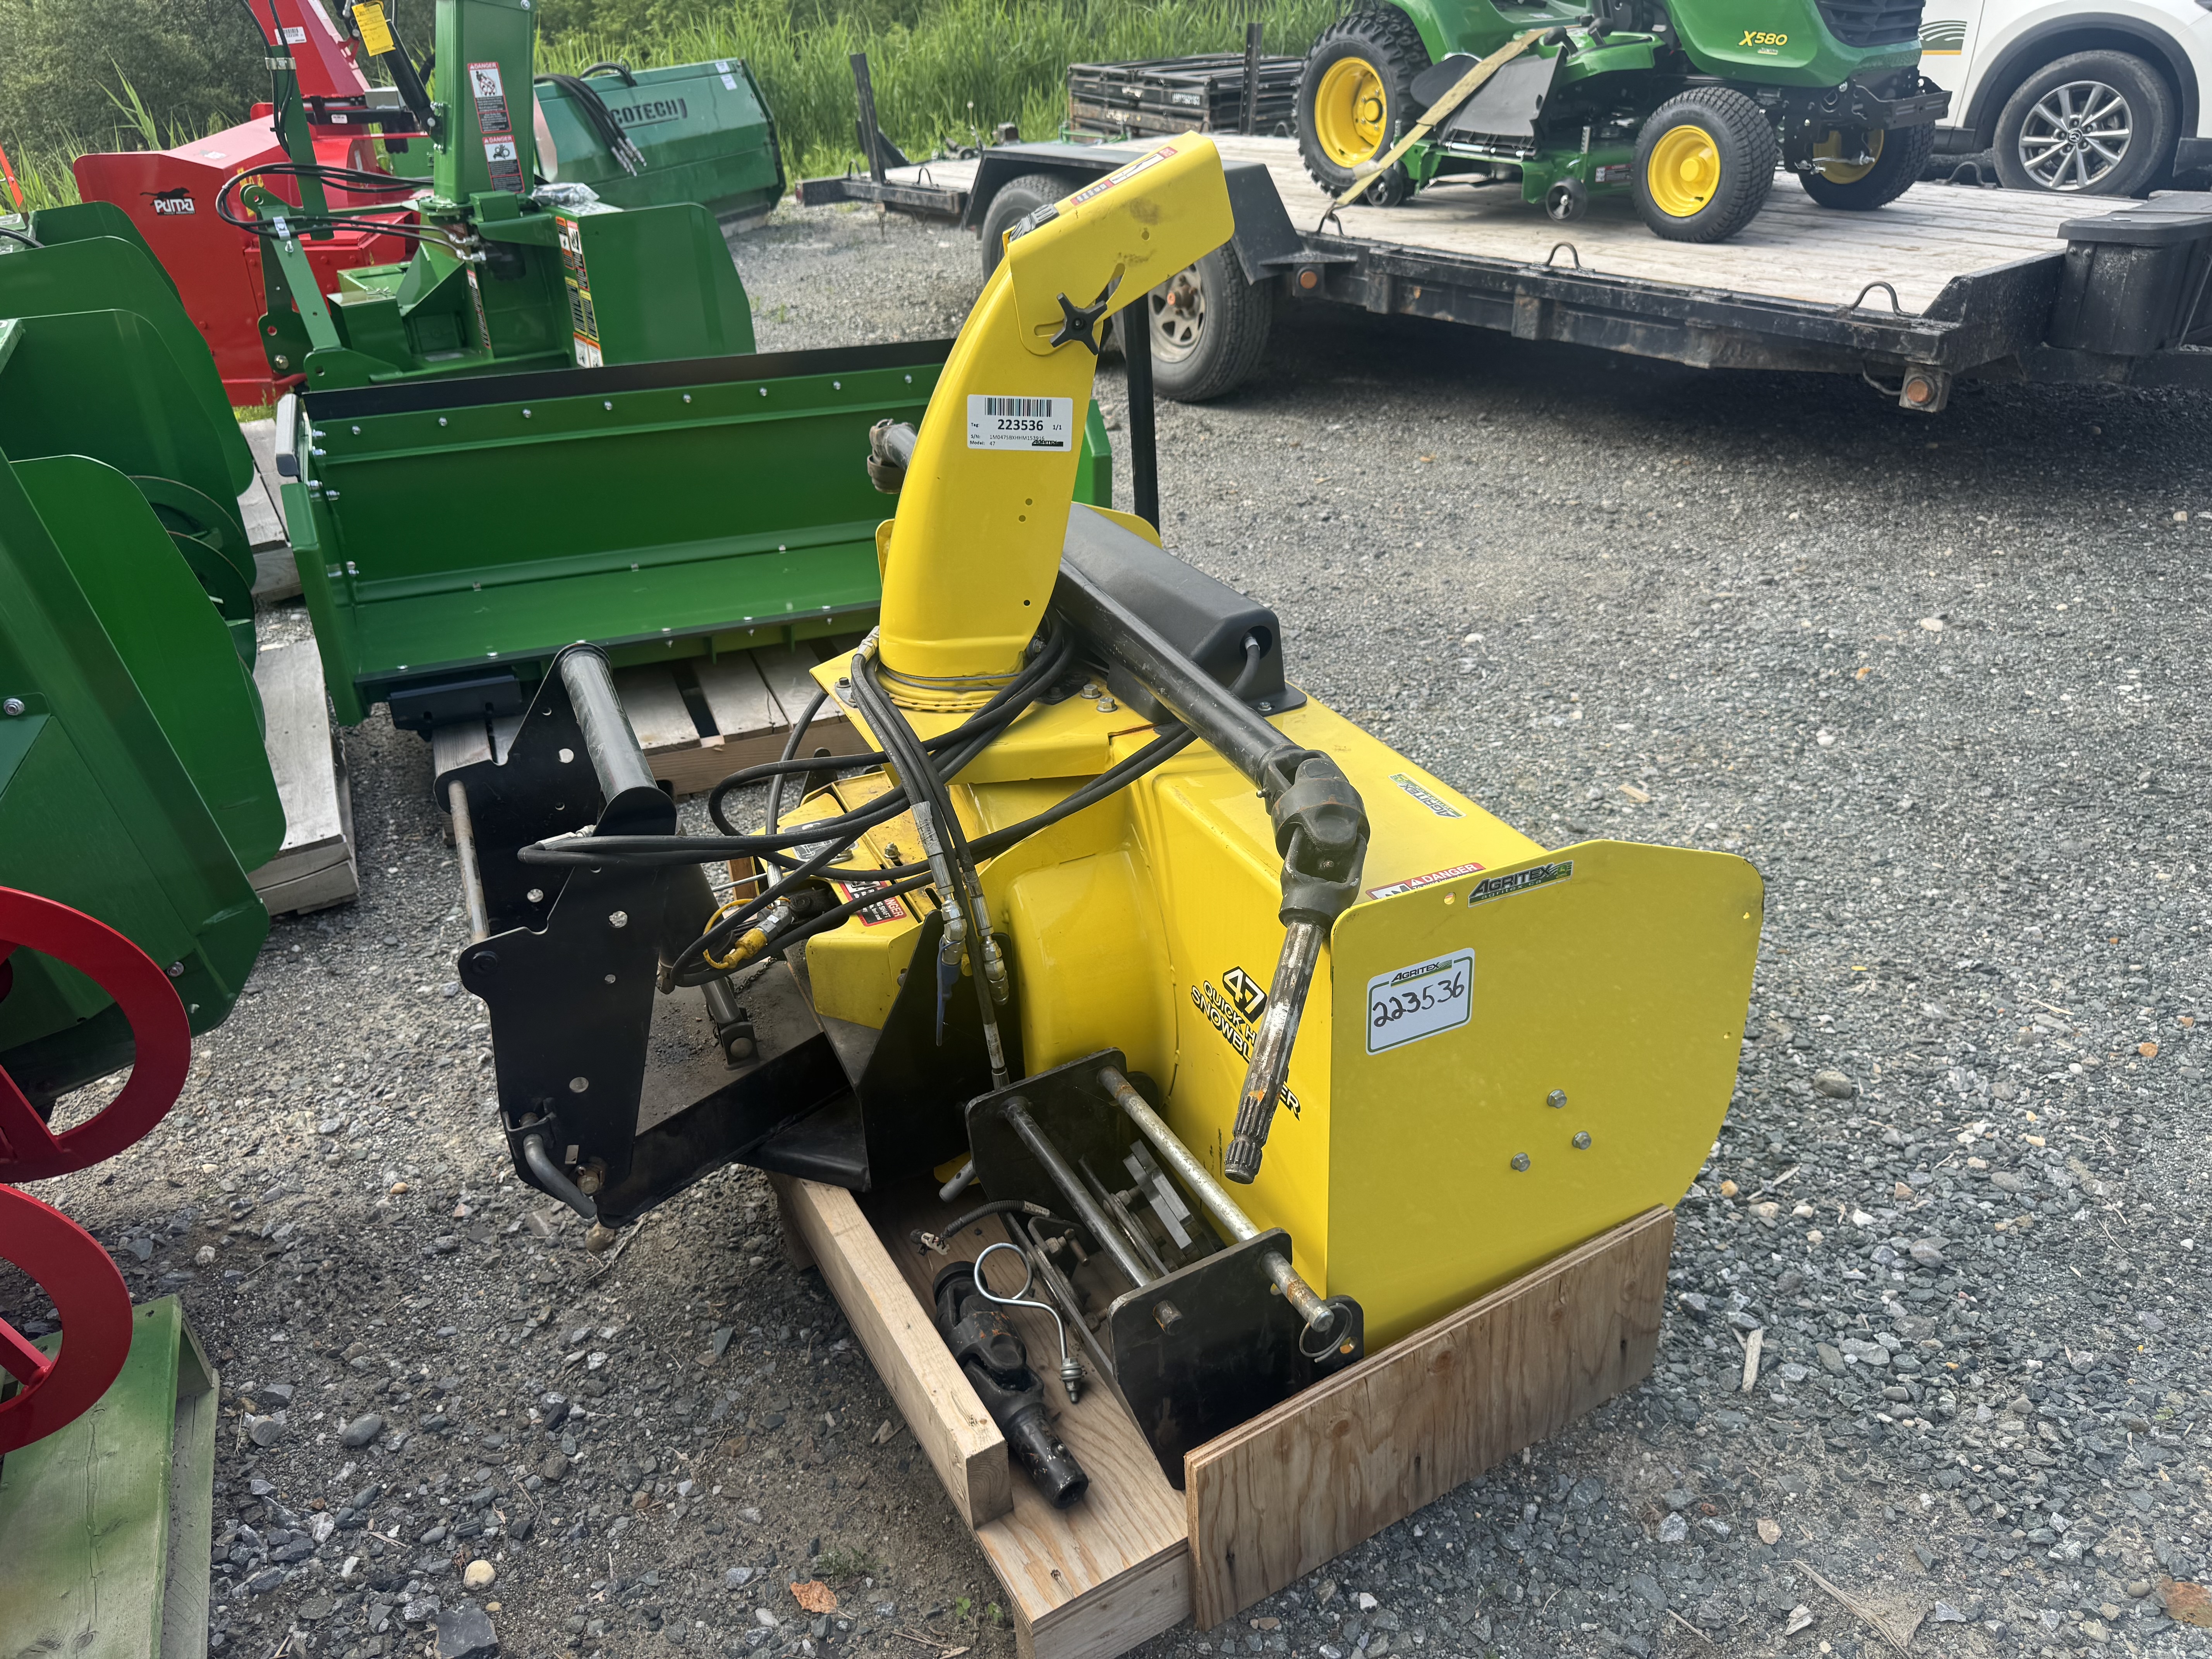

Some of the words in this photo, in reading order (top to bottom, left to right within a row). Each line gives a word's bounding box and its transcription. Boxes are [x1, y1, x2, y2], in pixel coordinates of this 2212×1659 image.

[1738, 31, 1788, 46] X580
[998, 419, 1043, 431] 223536
[1398, 783, 1458, 817] AGRITEX
[1421, 864, 1478, 883] DANGER
[1469, 863, 1553, 897] AGRITEX
[1482, 880, 1541, 899] agritex.ca
[879, 905, 891, 918] SHAFT
[884, 898, 904, 917] NGER
[1391, 962, 1440, 982] AGRITEX
[1223, 967, 1266, 1016] 47
[1372, 971, 1465, 1027] 223536
[1204, 981, 1245, 1033] QUICK
[1192, 986, 1299, 1117] SNOWBLER
